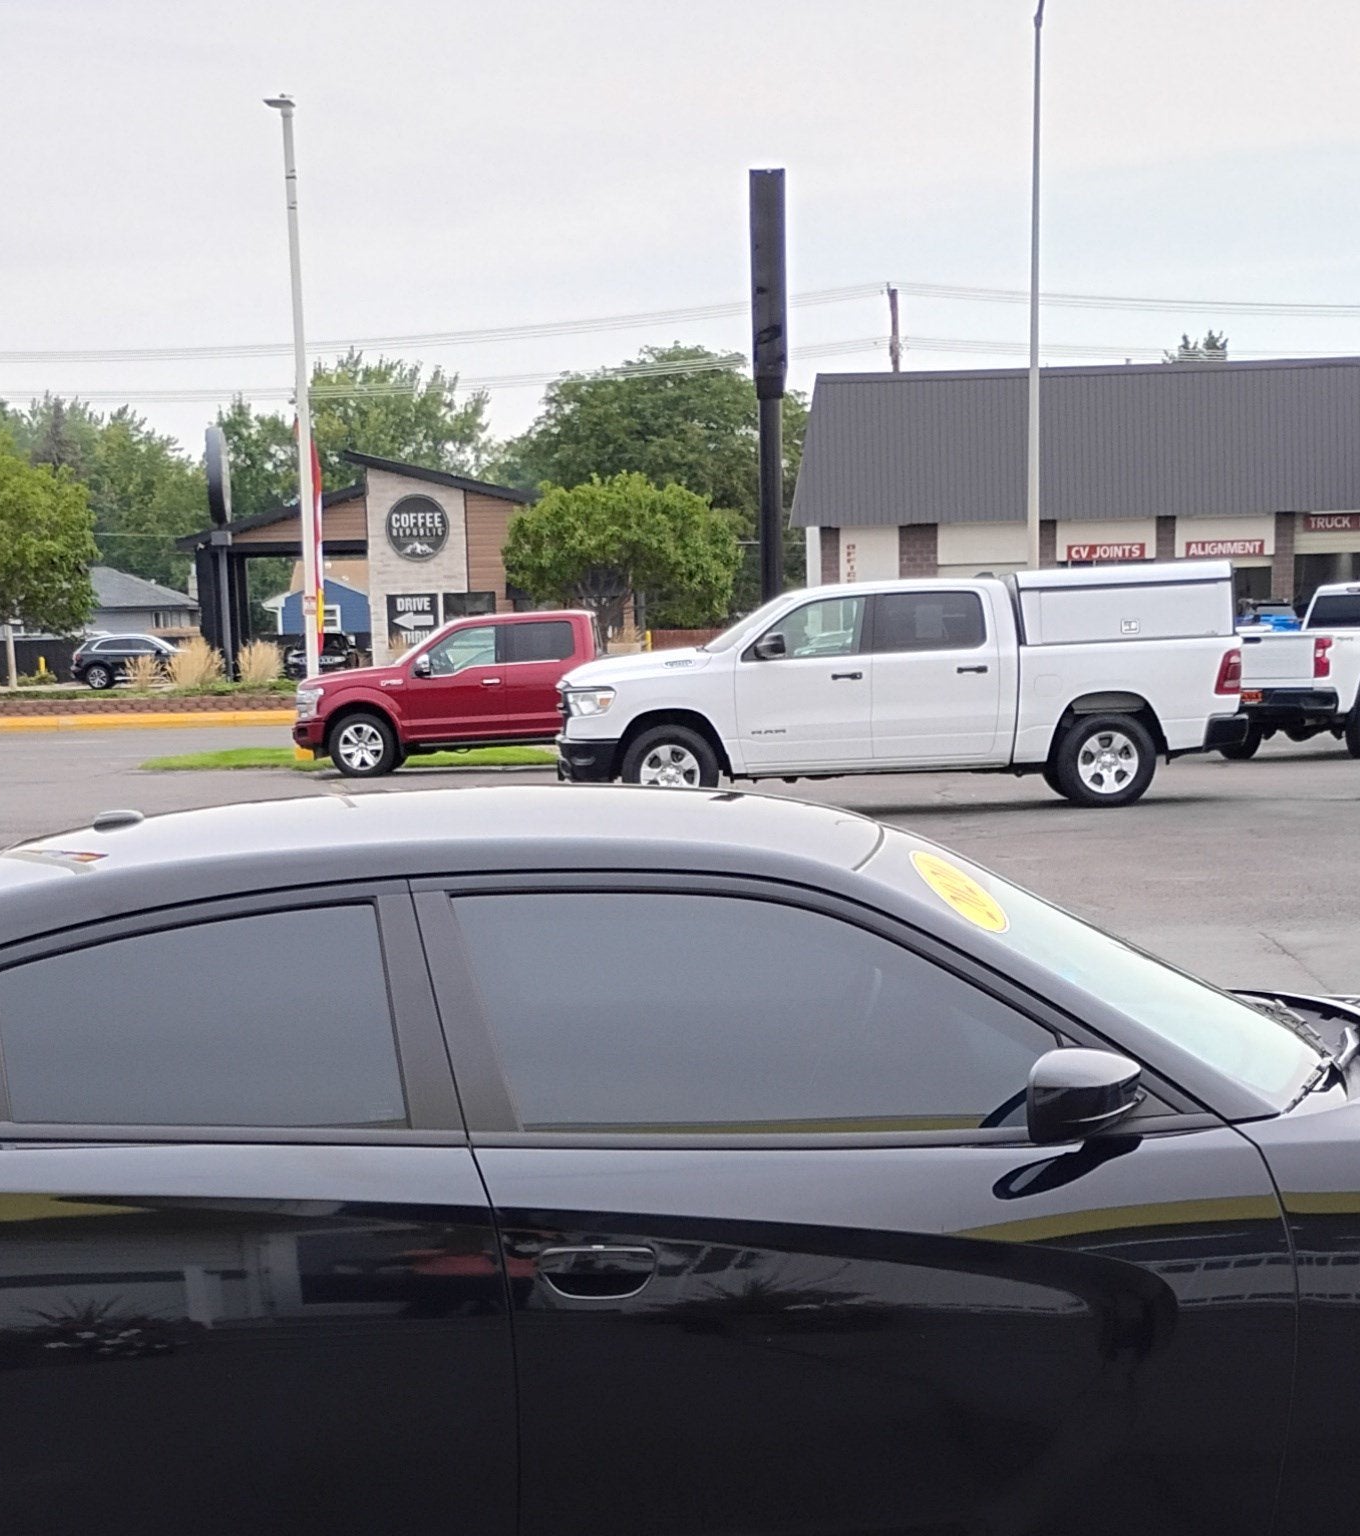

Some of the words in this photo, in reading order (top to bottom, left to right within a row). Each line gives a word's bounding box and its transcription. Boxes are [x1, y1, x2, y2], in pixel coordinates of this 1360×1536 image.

[391, 512, 442, 528] COFFEE
[1310, 517, 1350, 528] TRUCK
[1071, 546, 1089, 559] CV
[1092, 544, 1140, 558] JOINTS
[1189, 541, 1261, 556] ALIGNMENT
[396, 598, 431, 611] DRIVE
